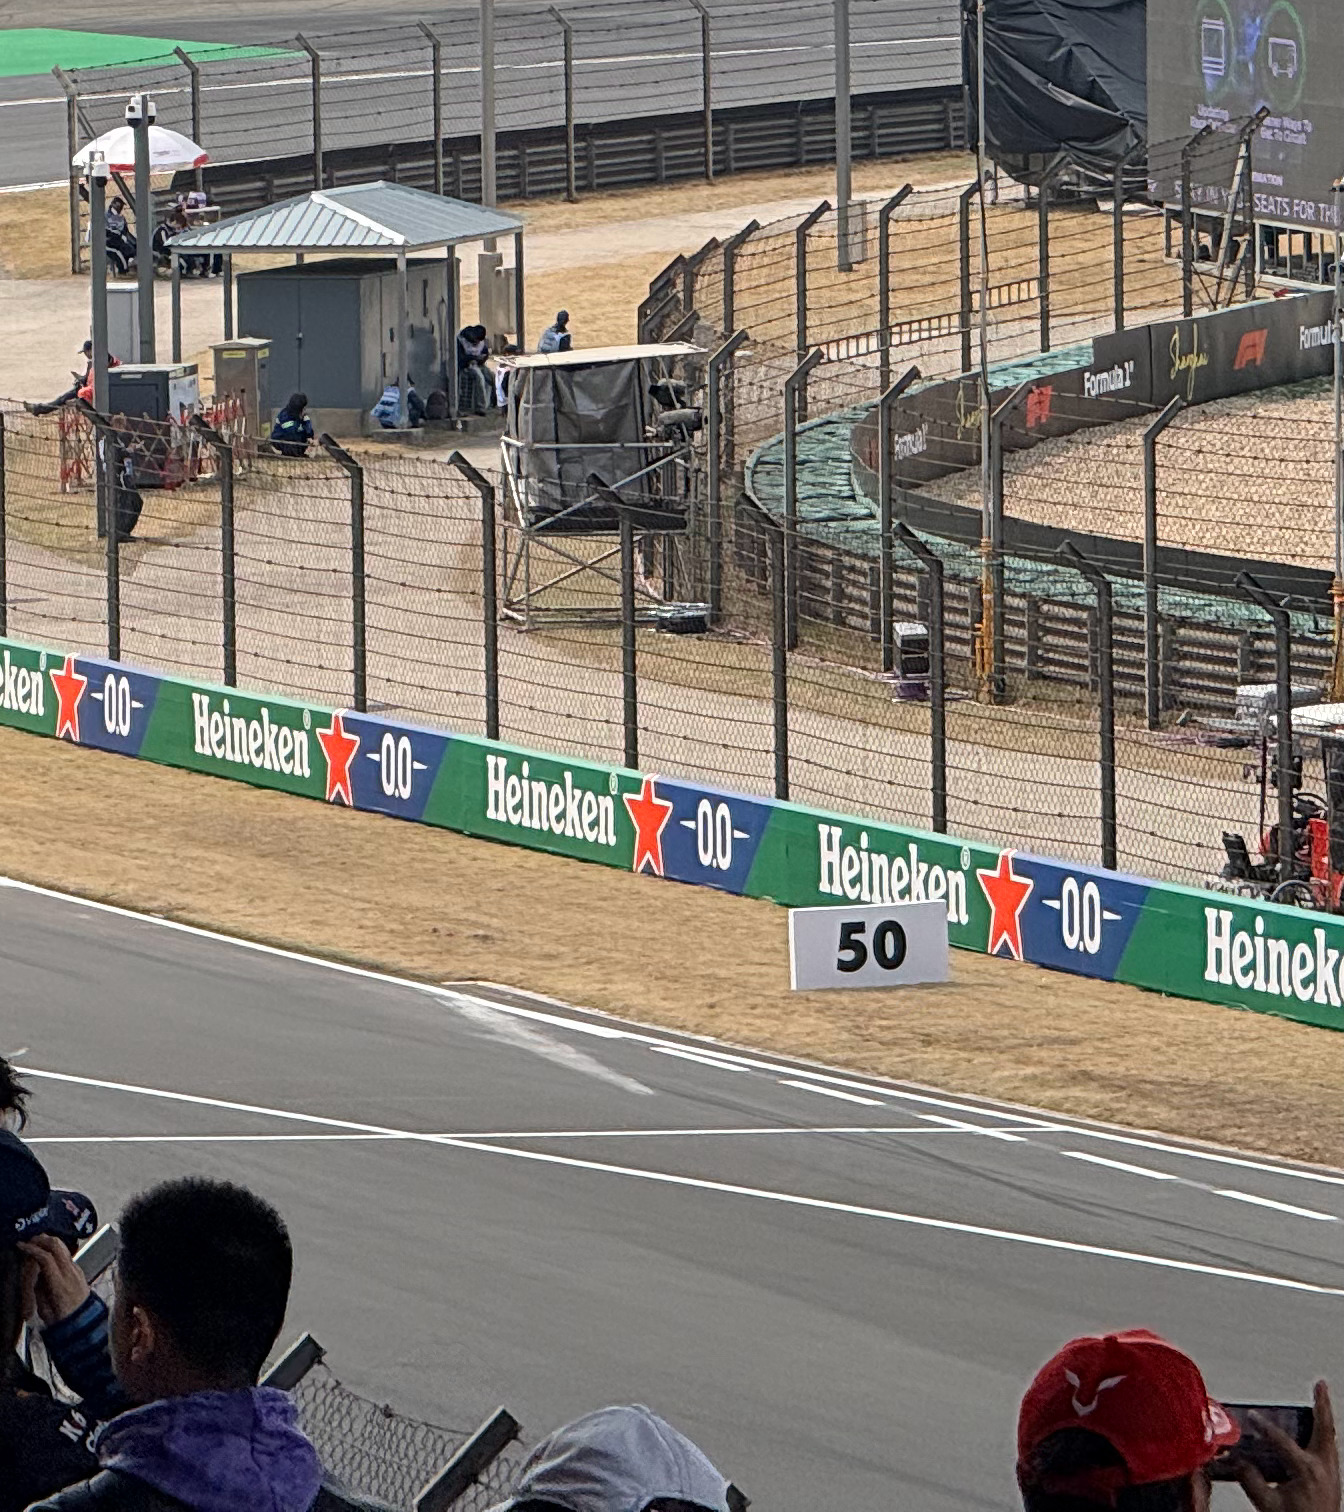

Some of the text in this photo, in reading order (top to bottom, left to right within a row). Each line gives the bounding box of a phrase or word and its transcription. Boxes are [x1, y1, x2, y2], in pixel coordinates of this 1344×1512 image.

[1254, 193, 1290, 216] SEATS
[1293, 199, 1316, 220] FOR
[192, 693, 311, 779] Heineken
[486, 755, 617, 846] Heineken
[836, 920, 907, 973] 50
[1204, 906, 1344, 1008] Heinek
